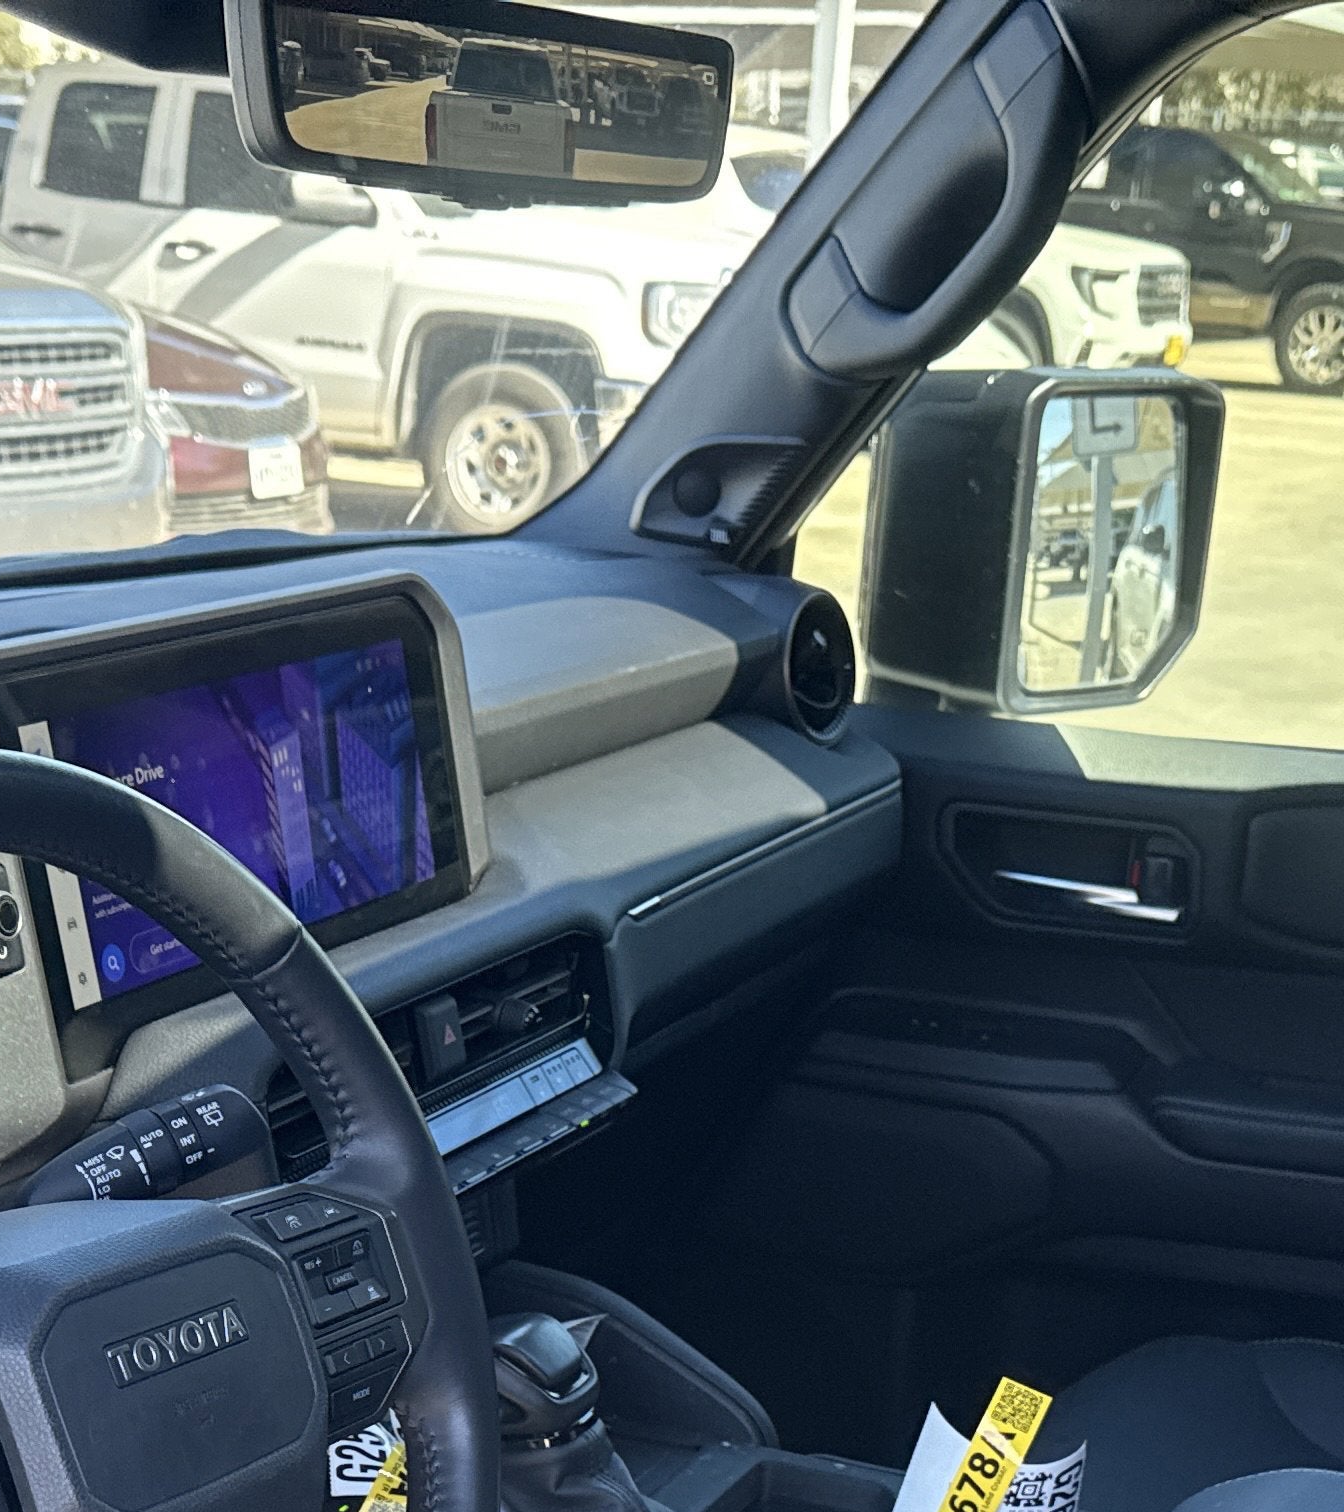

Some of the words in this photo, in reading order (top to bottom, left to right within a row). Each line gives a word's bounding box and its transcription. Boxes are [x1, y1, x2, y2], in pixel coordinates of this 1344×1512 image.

[135, 764, 164, 785] Drive
[196, 1101, 220, 1116] REAR
[171, 1117, 188, 1129] ON
[140, 1130, 164, 1143] AUTO
[179, 1134, 196, 1147] INT
[83, 1154, 105, 1168] MIST
[185, 1151, 203, 1164] OFF
[89, 1164, 107, 1177] OFF
[96, 1169, 121, 1185] AUTO
[98, 1185, 111, 1195] LO
[107, 1306, 248, 1381] TOYOTA
[353, 1387, 370, 1401] MODE
